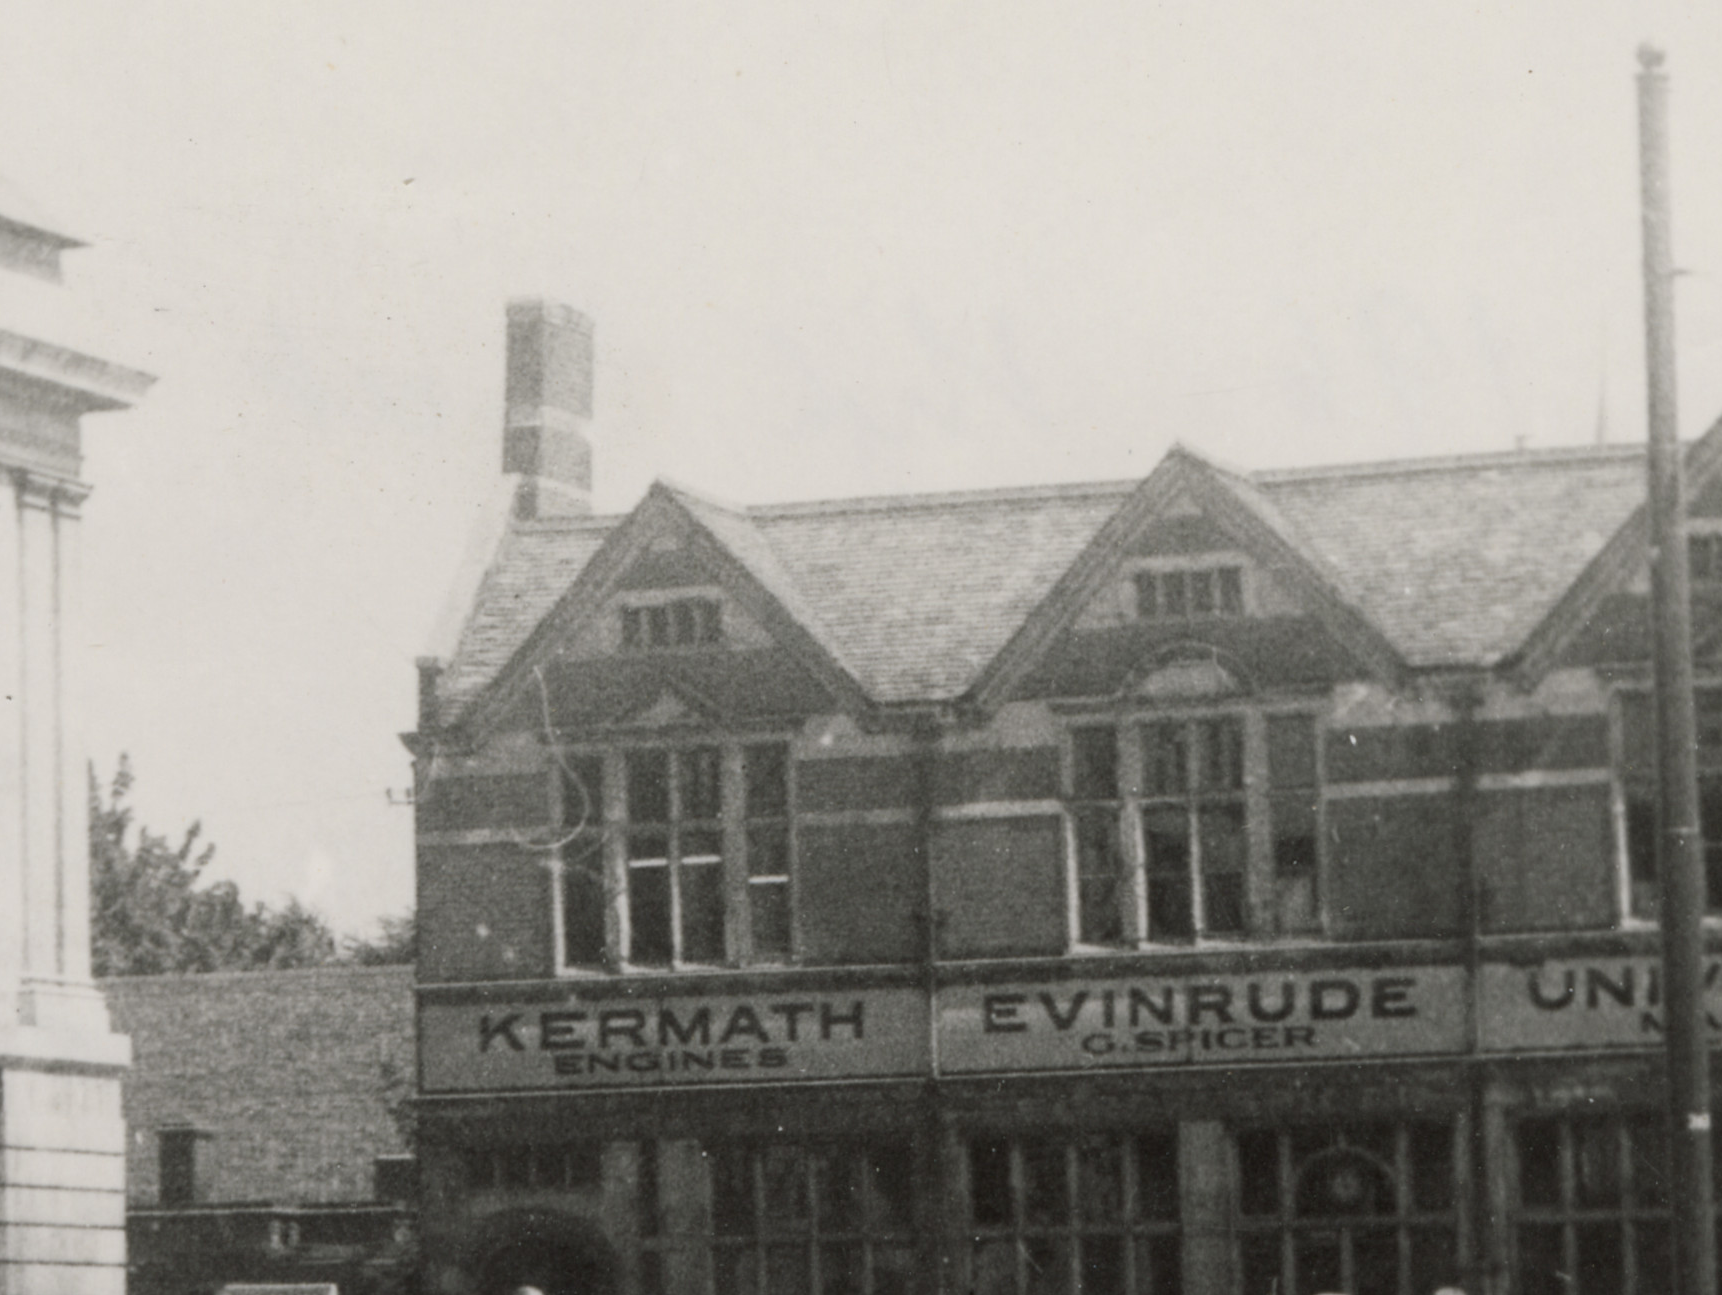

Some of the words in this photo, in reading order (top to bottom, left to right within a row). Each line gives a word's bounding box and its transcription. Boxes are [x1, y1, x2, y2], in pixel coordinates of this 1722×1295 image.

[479, 1000, 865, 1052] KERMATH
[983, 977, 1417, 1033] EVINRUDE
[553, 1046, 791, 1076] ENGINES
